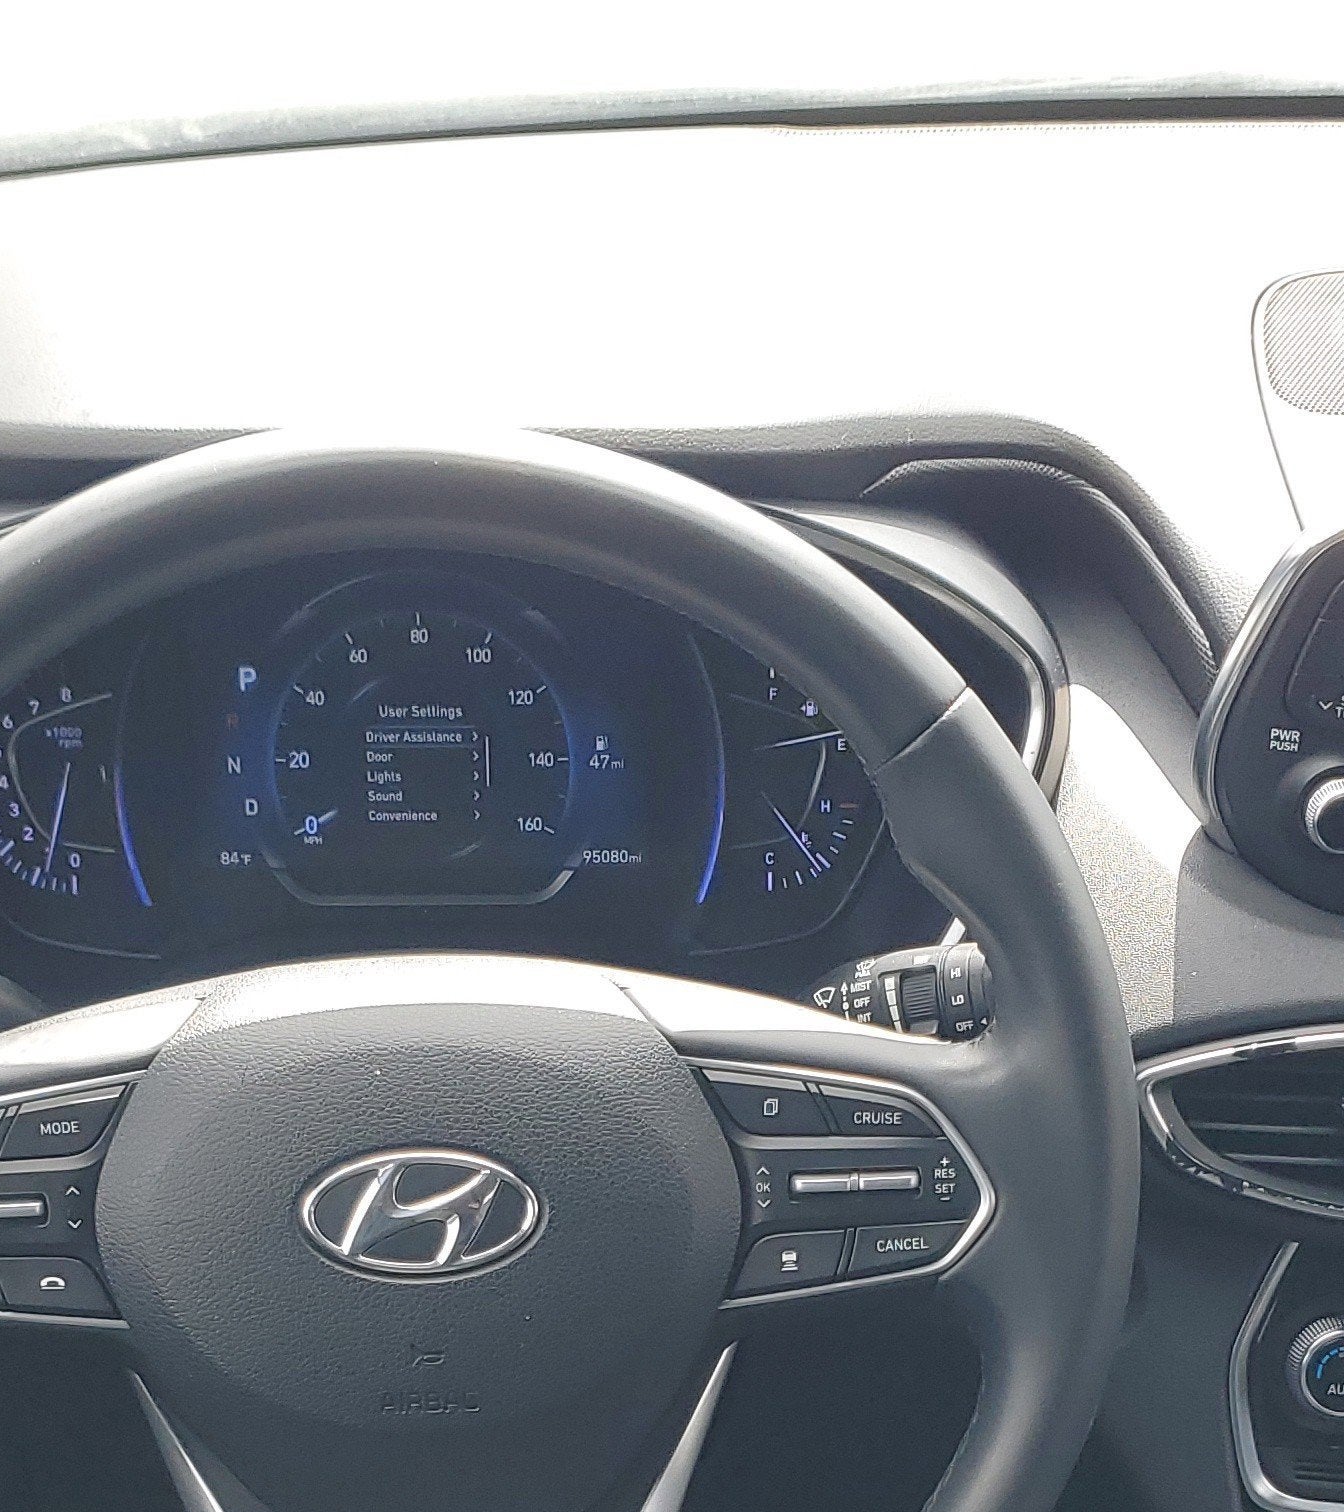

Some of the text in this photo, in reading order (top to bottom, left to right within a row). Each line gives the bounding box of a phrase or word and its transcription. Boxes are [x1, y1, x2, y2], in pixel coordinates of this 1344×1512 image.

[411, 629, 429, 643] 80
[349, 648, 368, 663] 60
[465, 648, 492, 663] 100
[238, 667, 257, 692] P
[60, 687, 72, 702] 8
[306, 690, 325, 706] 40
[508, 689, 534, 705] 120
[769, 688, 779, 700] F
[28, 700, 40, 715] 7
[378, 704, 464, 720] User Settings
[2, 715, 14, 730] 6
[365, 731, 463, 743] Driver Assistance
[1270, 728, 1300, 742] PWR
[837, 738, 847, 751] E
[1269, 741, 1299, 752] PUSH
[289, 752, 310, 769] 20
[366, 751, 394, 763] Door
[529, 752, 554, 767] 140
[227, 756, 241, 774] N
[367, 770, 402, 783] Lights
[368, 790, 403, 802] Sound
[9, 802, 20, 818] 3
[245, 799, 258, 816] D
[821, 800, 831, 813] H
[369, 810, 438, 822] Convenience
[305, 816, 318, 835] 0
[517, 817, 543, 832] 160
[22, 827, 35, 841] 2
[69, 853, 81, 868] 0
[765, 852, 775, 865] C
[950, 968, 961, 979] HI
[850, 980, 872, 993] MIST
[853, 996, 871, 1009] OFF
[951, 994, 964, 1006] LO
[955, 1021, 974, 1033] OFF
[853, 1112, 903, 1125] CRUISE
[40, 1121, 80, 1136] MODE
[934, 1168, 956, 1179] RES
[756, 1182, 771, 1193] OK
[934, 1183, 956, 1194] SET
[876, 1237, 929, 1252] CANCEL
